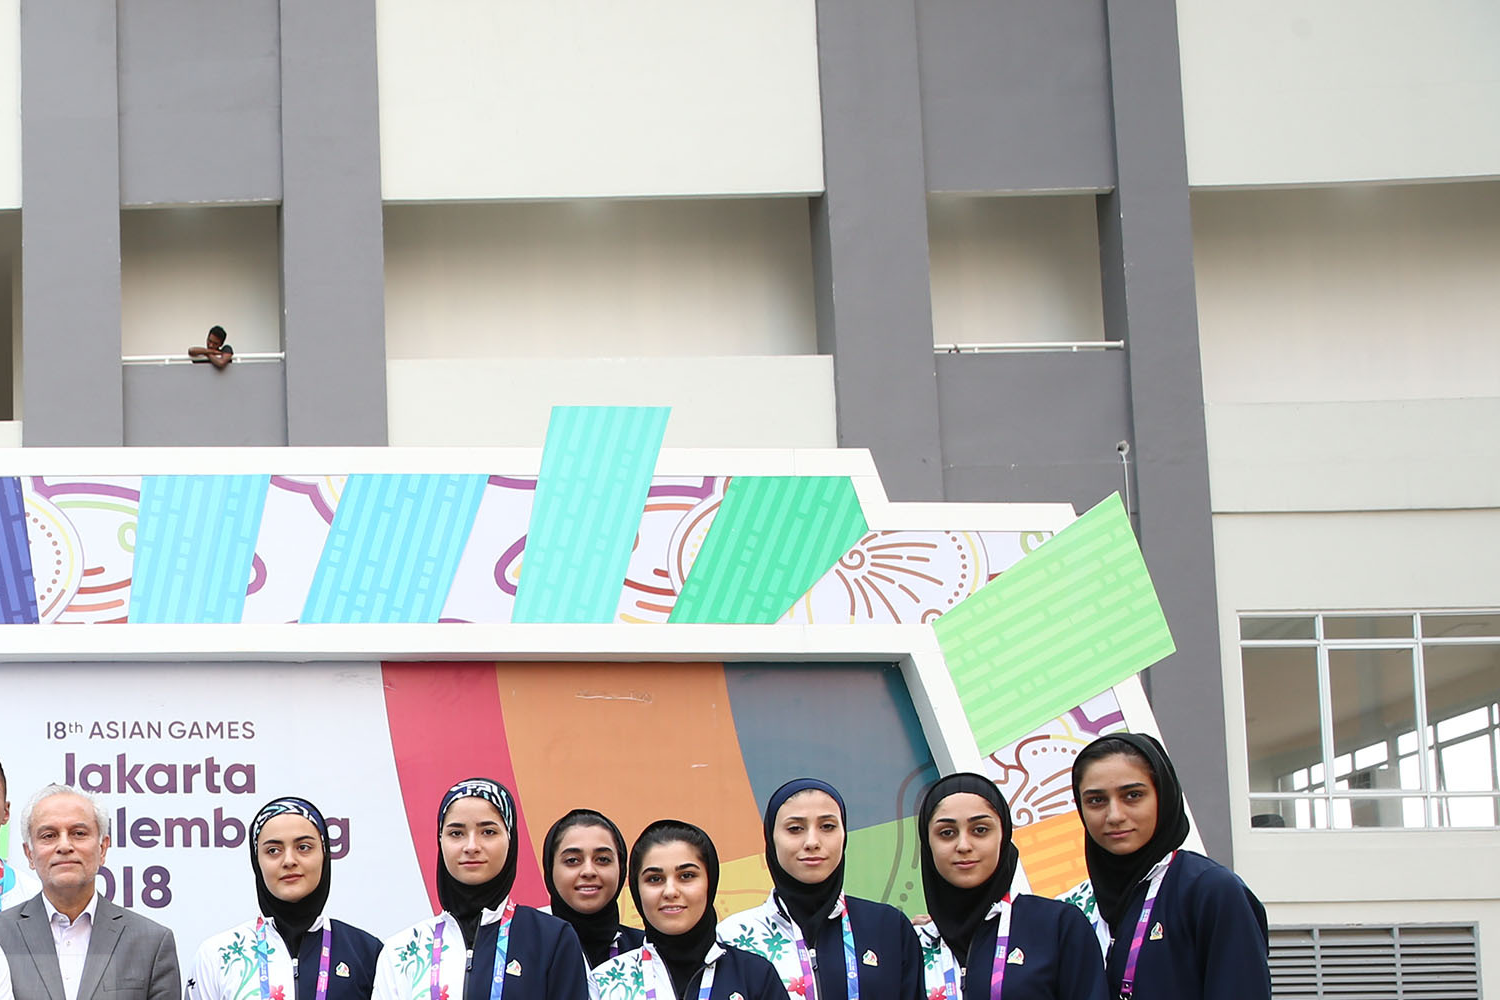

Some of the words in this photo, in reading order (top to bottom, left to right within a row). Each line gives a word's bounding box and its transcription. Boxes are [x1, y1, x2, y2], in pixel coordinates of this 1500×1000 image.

[46, 721, 83, 740] 18th
[89, 721, 162, 740] ASIAN
[168, 721, 256, 740] GAMES
[51, 752, 256, 794] Jakarta
[108, 807, 350, 860] lembg
